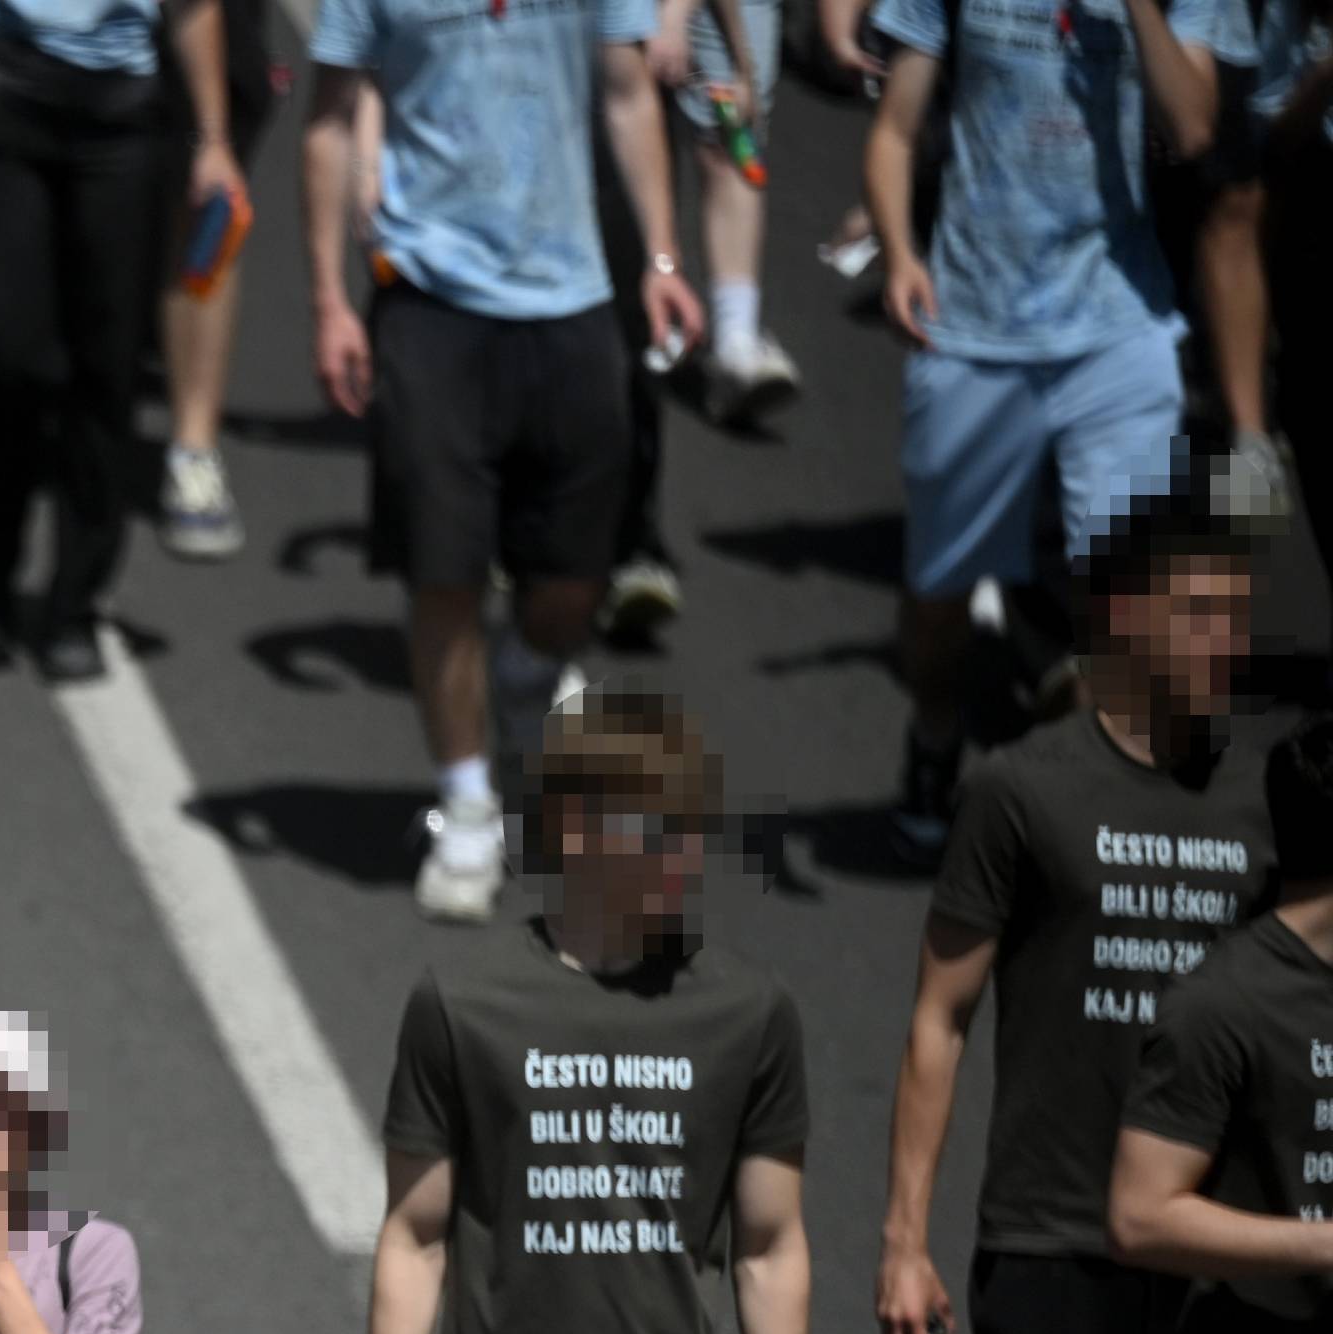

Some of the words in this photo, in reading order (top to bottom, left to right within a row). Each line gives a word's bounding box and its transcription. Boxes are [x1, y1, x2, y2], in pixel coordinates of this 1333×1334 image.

[1096, 824, 1174, 868] ČESTO
[1177, 835, 1249, 874] NISMO
[1101, 882, 1149, 919] BILI
[1152, 884, 1170, 920] U
[1093, 935, 1173, 974] DOBRO
[1084, 986, 1133, 1024] KAJ
[525, 1048, 609, 1088] ČESTO
[613, 1054, 694, 1091] NISMO
[530, 1109, 581, 1144] BILI
[585, 1109, 604, 1143] U
[527, 1164, 612, 1199] DOBRO
[613, 1163, 685, 1200] ZNATE
[523, 1220, 576, 1254] KAJ
[580, 1219, 634, 1254] NAS
